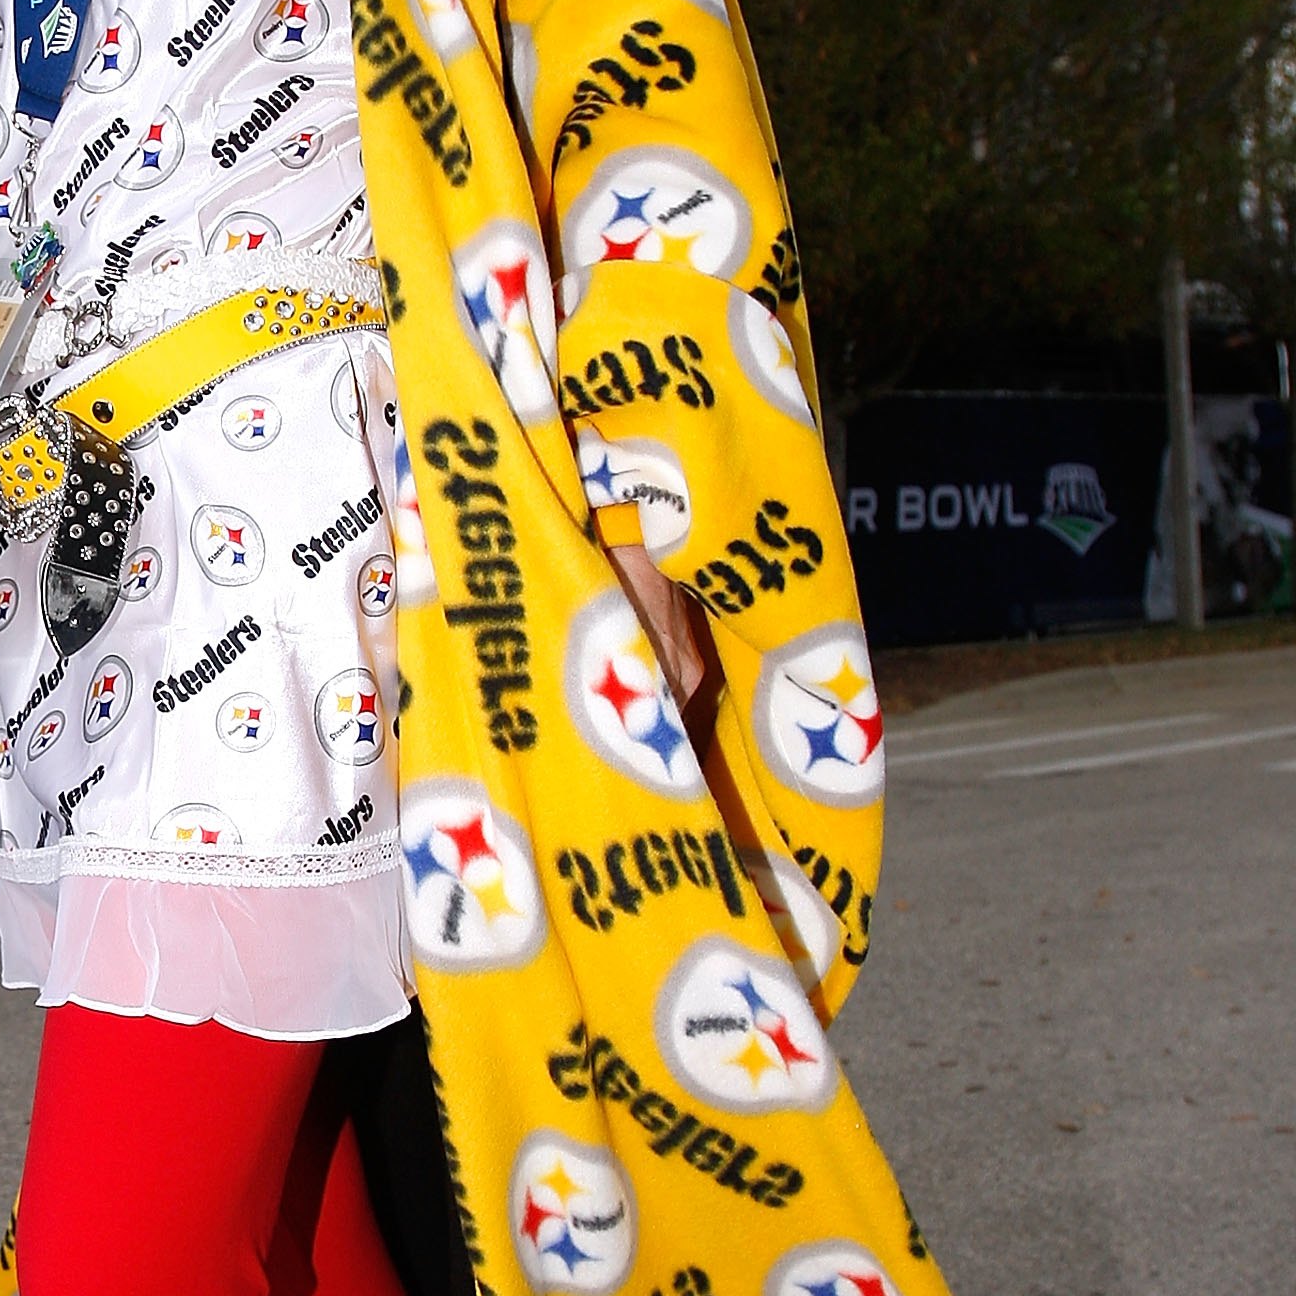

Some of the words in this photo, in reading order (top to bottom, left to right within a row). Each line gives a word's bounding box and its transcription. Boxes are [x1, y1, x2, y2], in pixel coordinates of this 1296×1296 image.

[53, 117, 131, 217] Steelers
[211, 74, 315, 169] Steelers
[896, 483, 1030, 533] BOWL
[152, 614, 263, 714] Steelers
